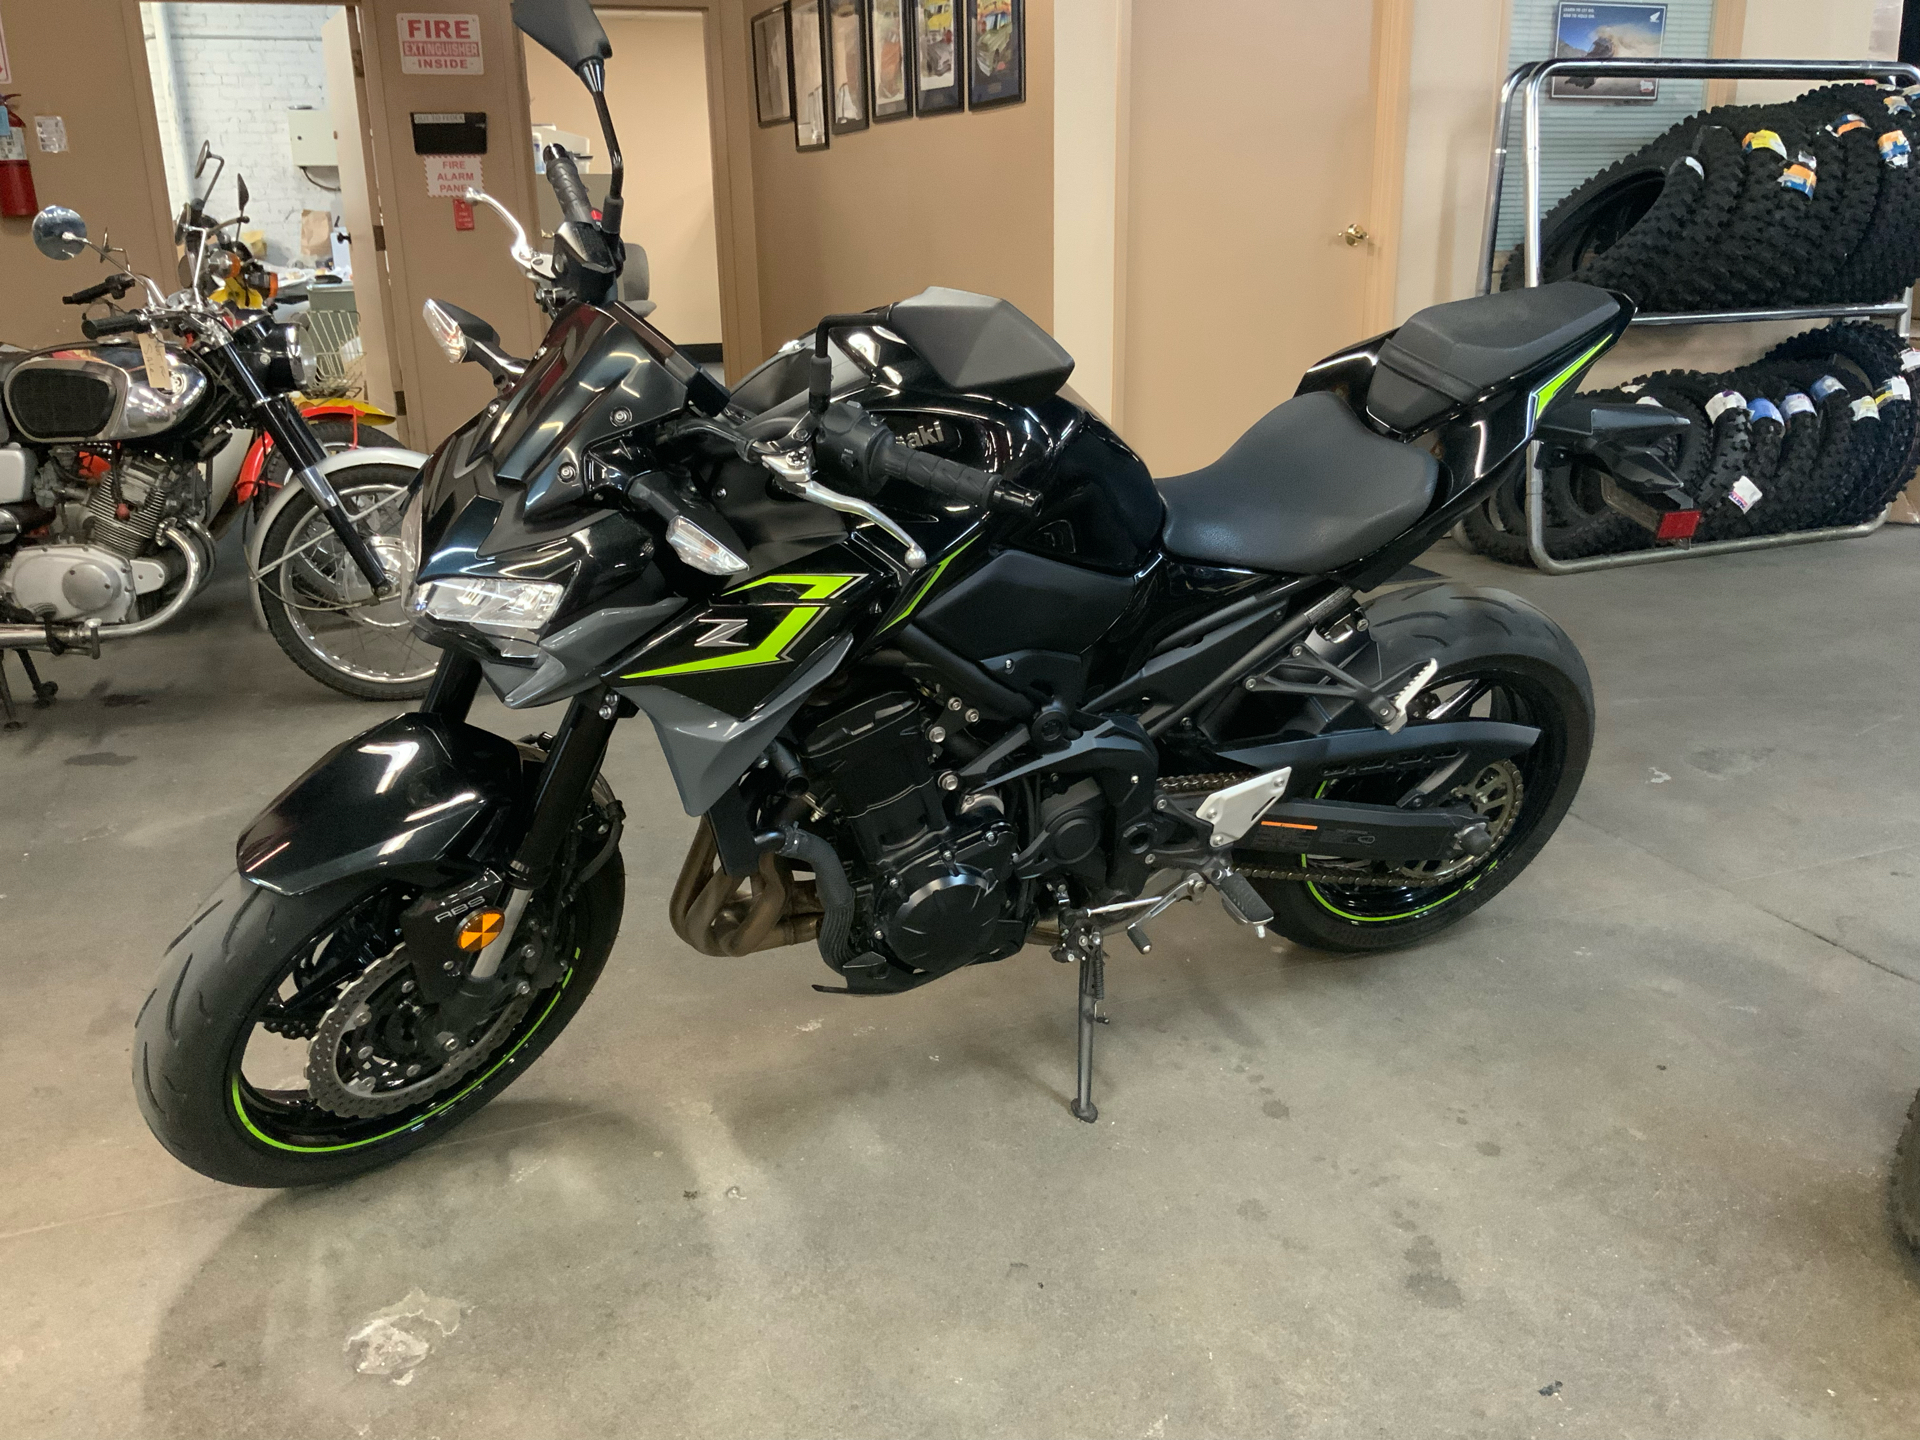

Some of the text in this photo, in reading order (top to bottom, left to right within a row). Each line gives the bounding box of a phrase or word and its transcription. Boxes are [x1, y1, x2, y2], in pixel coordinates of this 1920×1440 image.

[407, 19, 471, 39] FIRE
[403, 42, 478, 56] EXTINGUISHER
[417, 59, 469, 69] INSIDE
[442, 161, 466, 169] FIRE
[437, 172, 475, 181] ALARM
[439, 184, 467, 193] PANE
[434, 895, 486, 923] ABS
